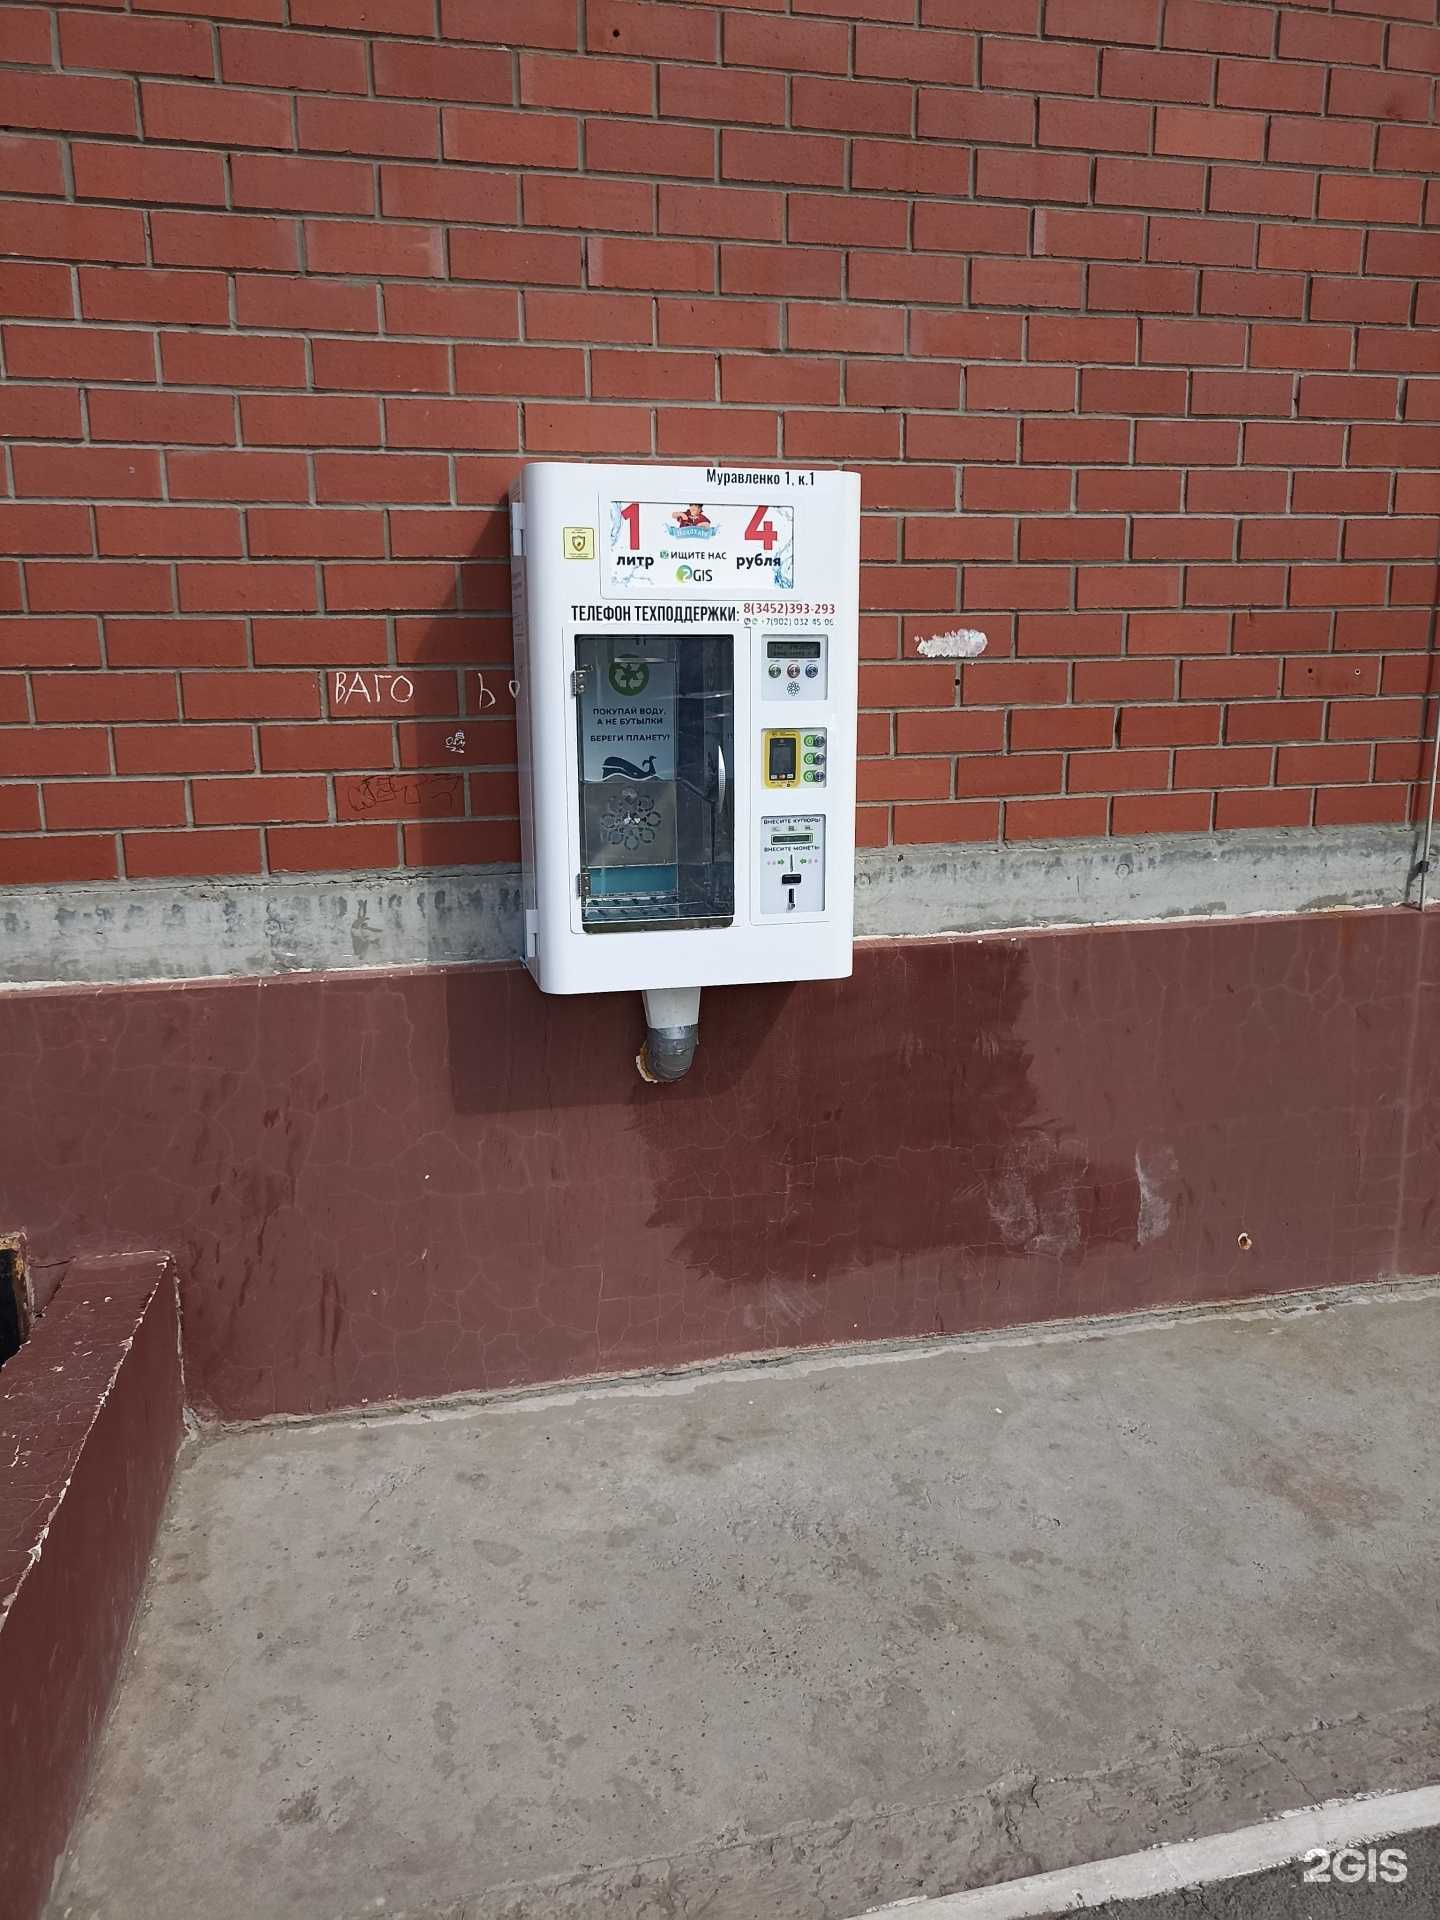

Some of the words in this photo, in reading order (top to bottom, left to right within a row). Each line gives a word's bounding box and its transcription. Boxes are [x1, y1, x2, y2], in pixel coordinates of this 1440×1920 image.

[706, 468, 780, 486] Муравленко
[798, 472, 815, 486] к.1
[621, 502, 640, 550] 1
[744, 504, 778, 551] 4
[616, 556, 655, 569] литр
[670, 551, 705, 560] ИЩИТЕ
[708, 552, 727, 560] НАС
[736, 553, 781, 569] рубля
[571, 605, 631, 622] ТЕЛЕФОН
[634, 605, 740, 624] ТЕХПОДДЕРЖКИ:
[743, 602, 835, 616] 8(3452)393-293
[593, 706, 638, 715] ПОКУПАЙ
[619, 717, 663, 726] БУТЫЛКИ
